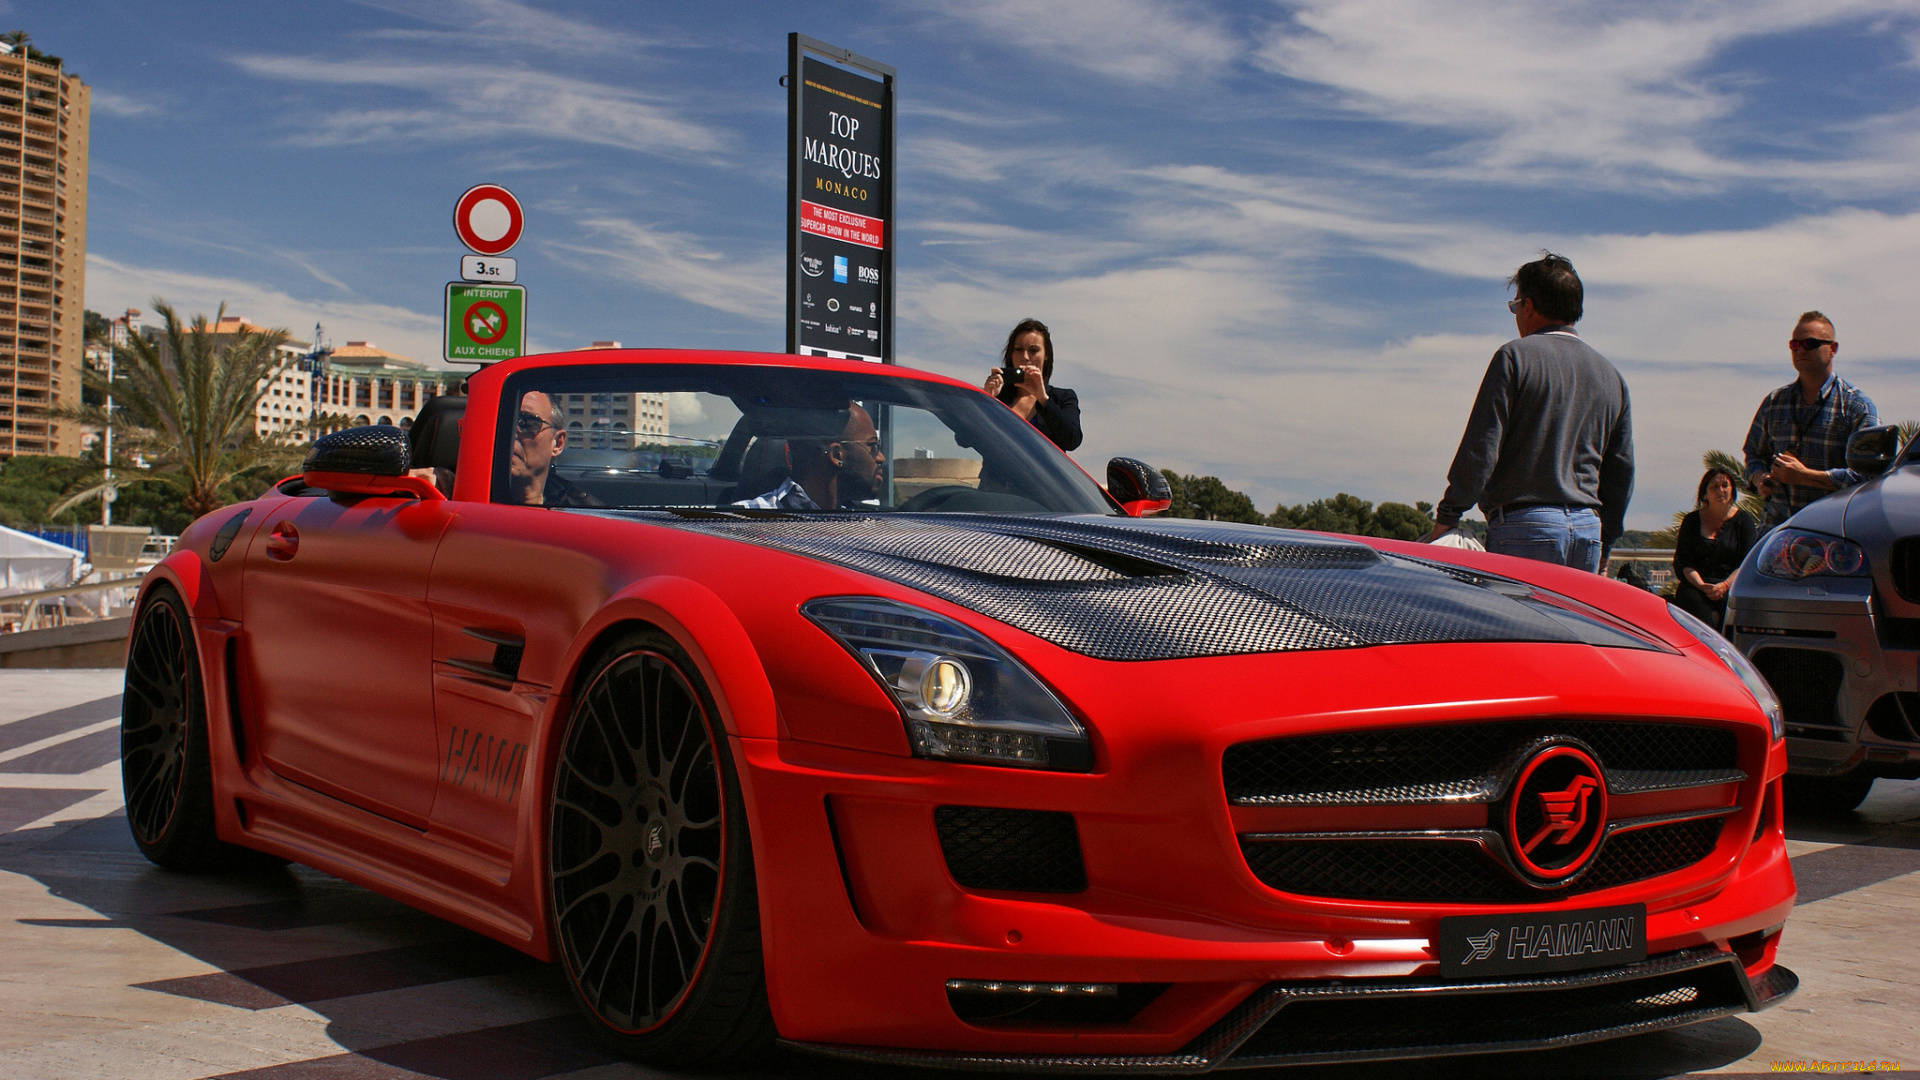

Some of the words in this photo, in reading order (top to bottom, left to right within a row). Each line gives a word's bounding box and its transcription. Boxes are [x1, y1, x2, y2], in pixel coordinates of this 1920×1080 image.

[829, 111, 860, 141] TOP
[804, 136, 881, 179] MARQUES
[815, 177, 867, 201] MONACO
[813, 206, 823, 218] THE
[823, 209, 838, 222] MOST
[839, 213, 867, 229] EXCLUSIVE
[800, 218, 826, 233] SUPERCAR
[827, 224, 842, 237] SHOW
[843, 228, 850, 238] IN
[850, 229, 860, 241] THE
[861, 232, 880, 245] WORLD
[858, 265, 879, 281] BOSS
[463, 288, 509, 299] INTERDIT
[454, 346, 475, 355] AUX
[477, 346, 515, 357] CHIENS
[1507, 916, 1635, 960] HAMANN
